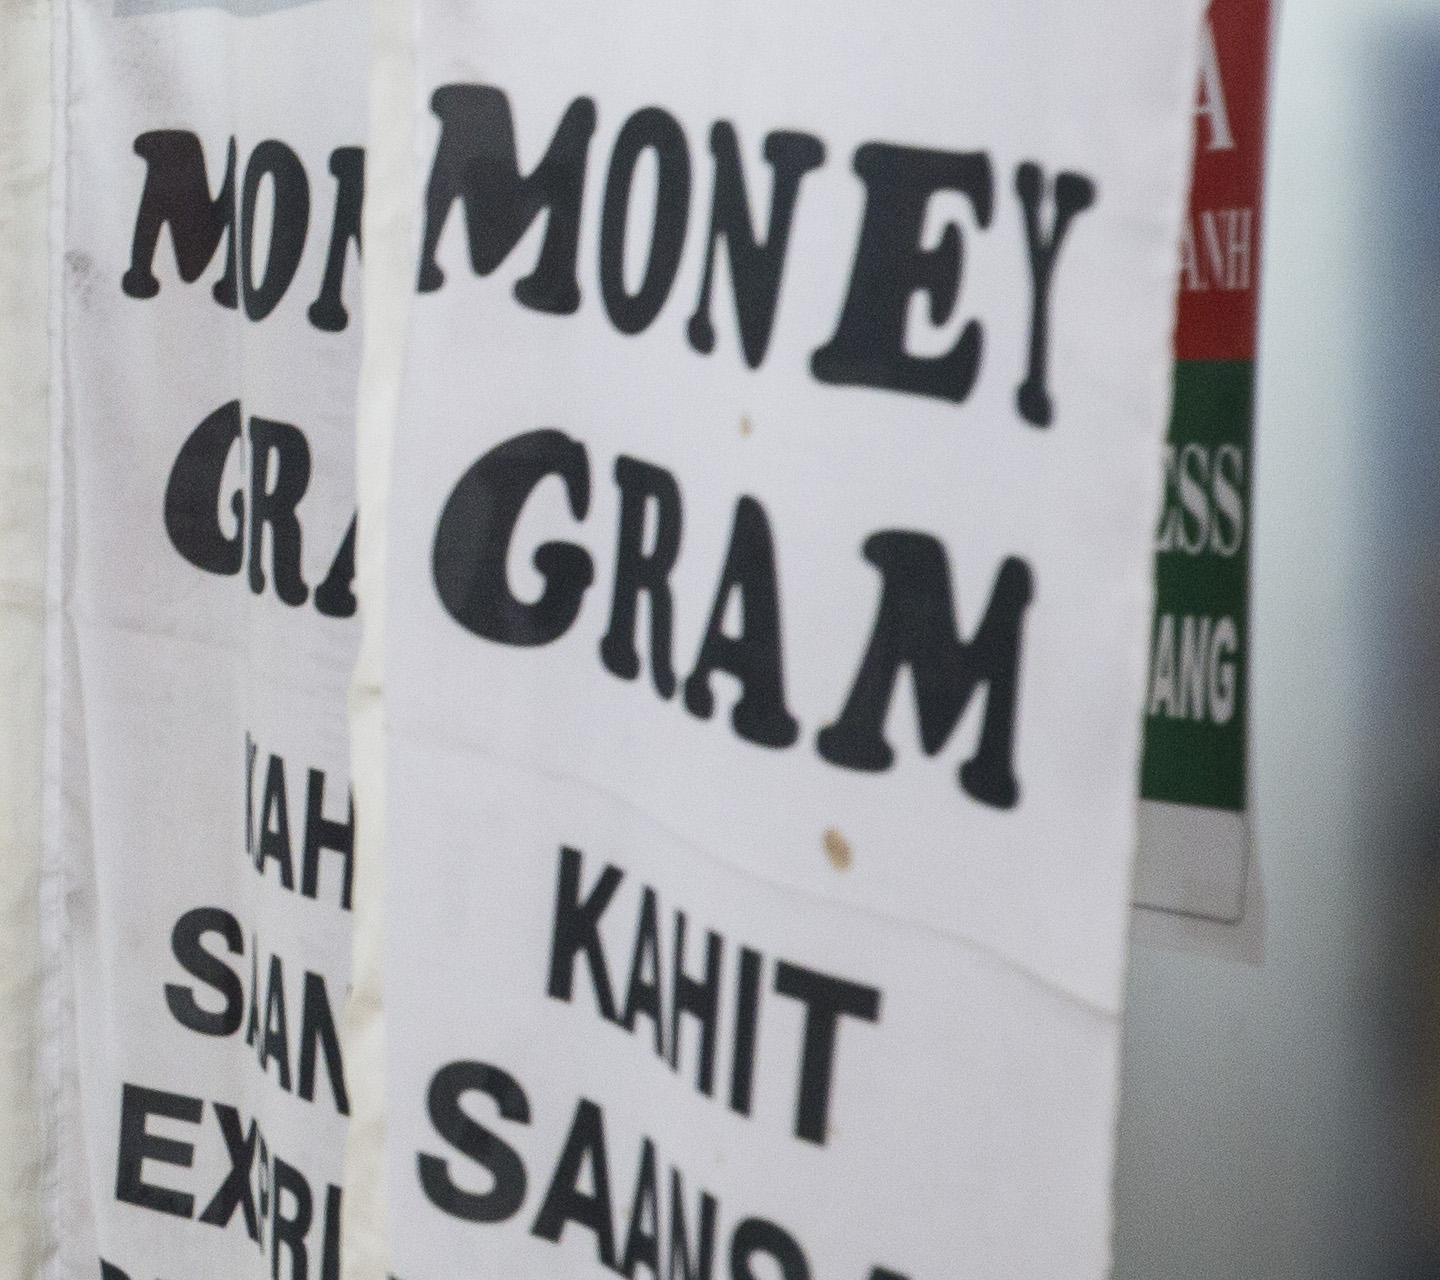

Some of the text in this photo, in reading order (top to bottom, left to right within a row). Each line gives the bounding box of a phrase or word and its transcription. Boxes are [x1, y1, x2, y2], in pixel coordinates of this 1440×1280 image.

[120, 128, 366, 333] MON
[417, 82, 1098, 428] MONEY
[162, 400, 359, 619] GRA
[431, 428, 1036, 810] GRAM
[544, 842, 884, 1148] KAHIT
